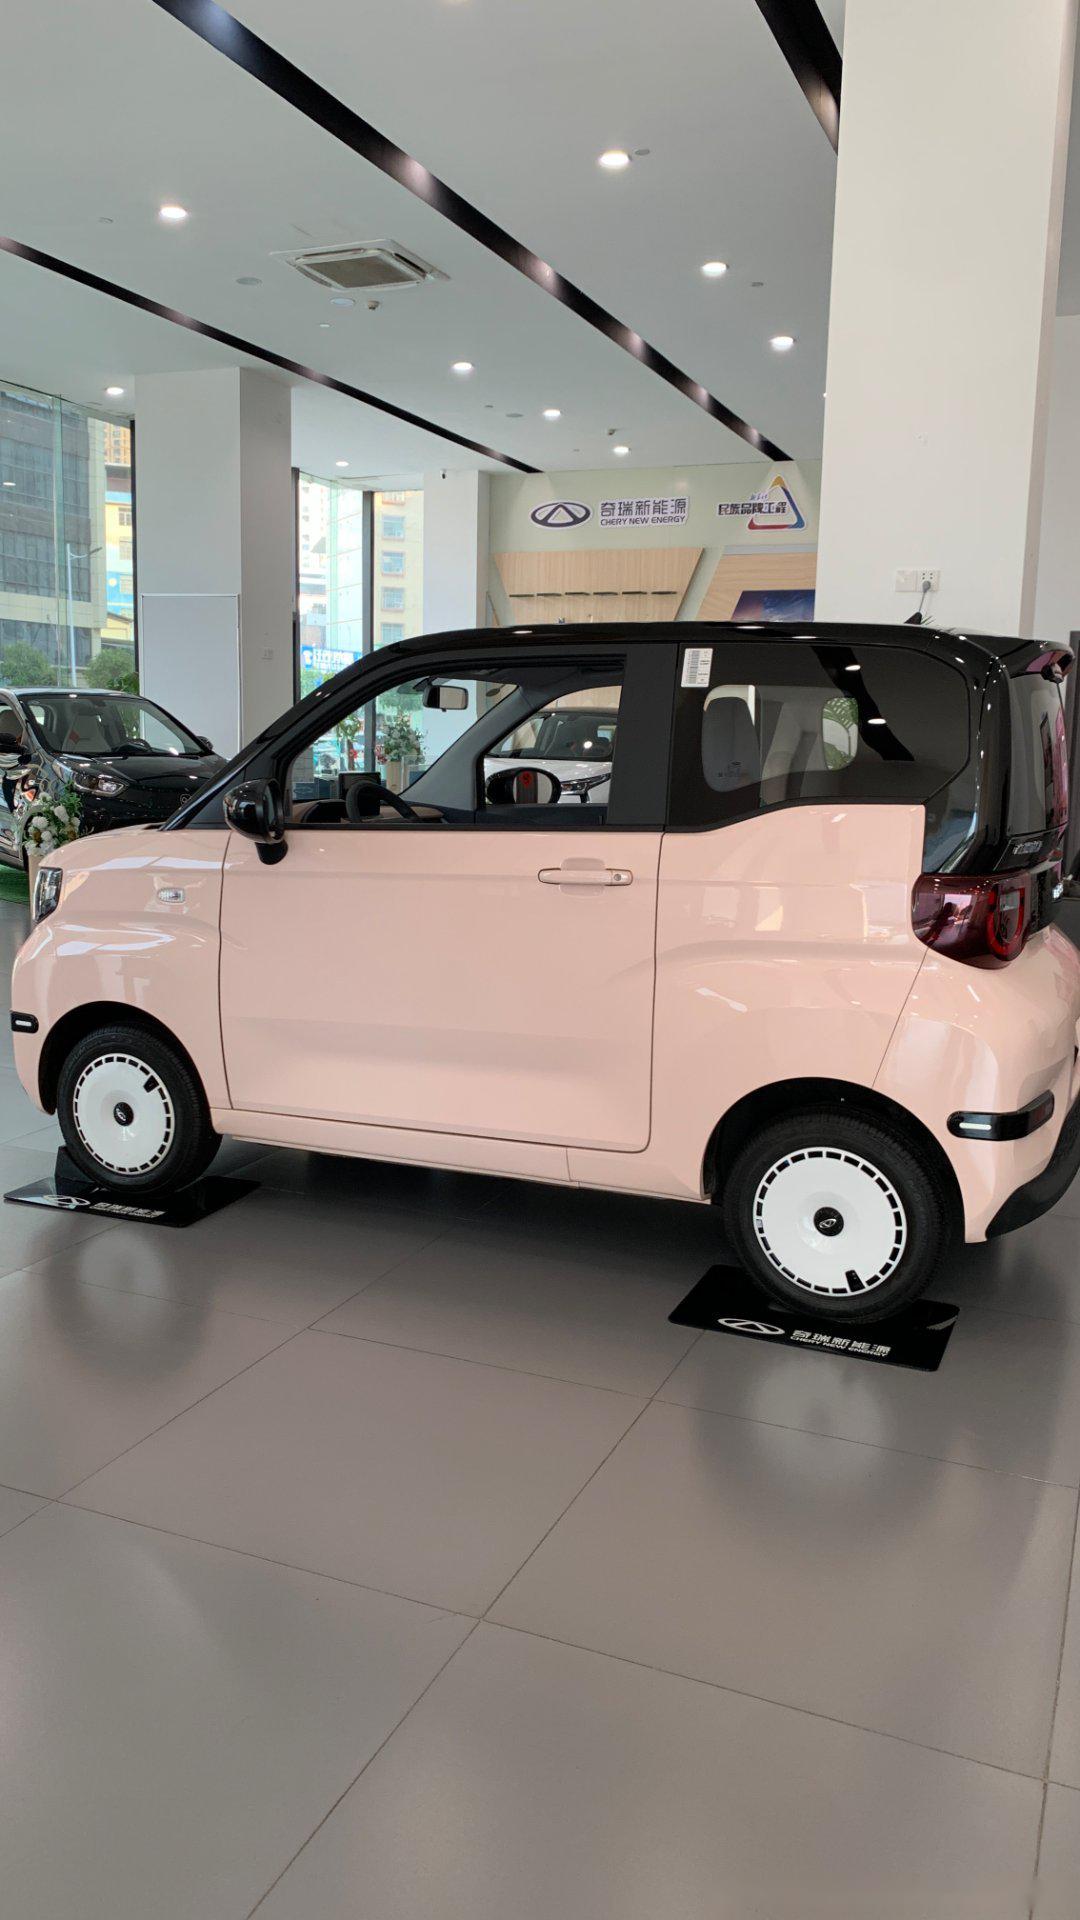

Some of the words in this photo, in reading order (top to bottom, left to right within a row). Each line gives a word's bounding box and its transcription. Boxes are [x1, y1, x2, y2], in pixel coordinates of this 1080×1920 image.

[600, 498, 686, 517] 奇瑞新能源
[718, 502, 787, 515] 民族品牌工程
[600, 518, 628, 526] CHERY
[629, 517, 650, 525] NEW
[651, 515, 686, 524] ENERGY
